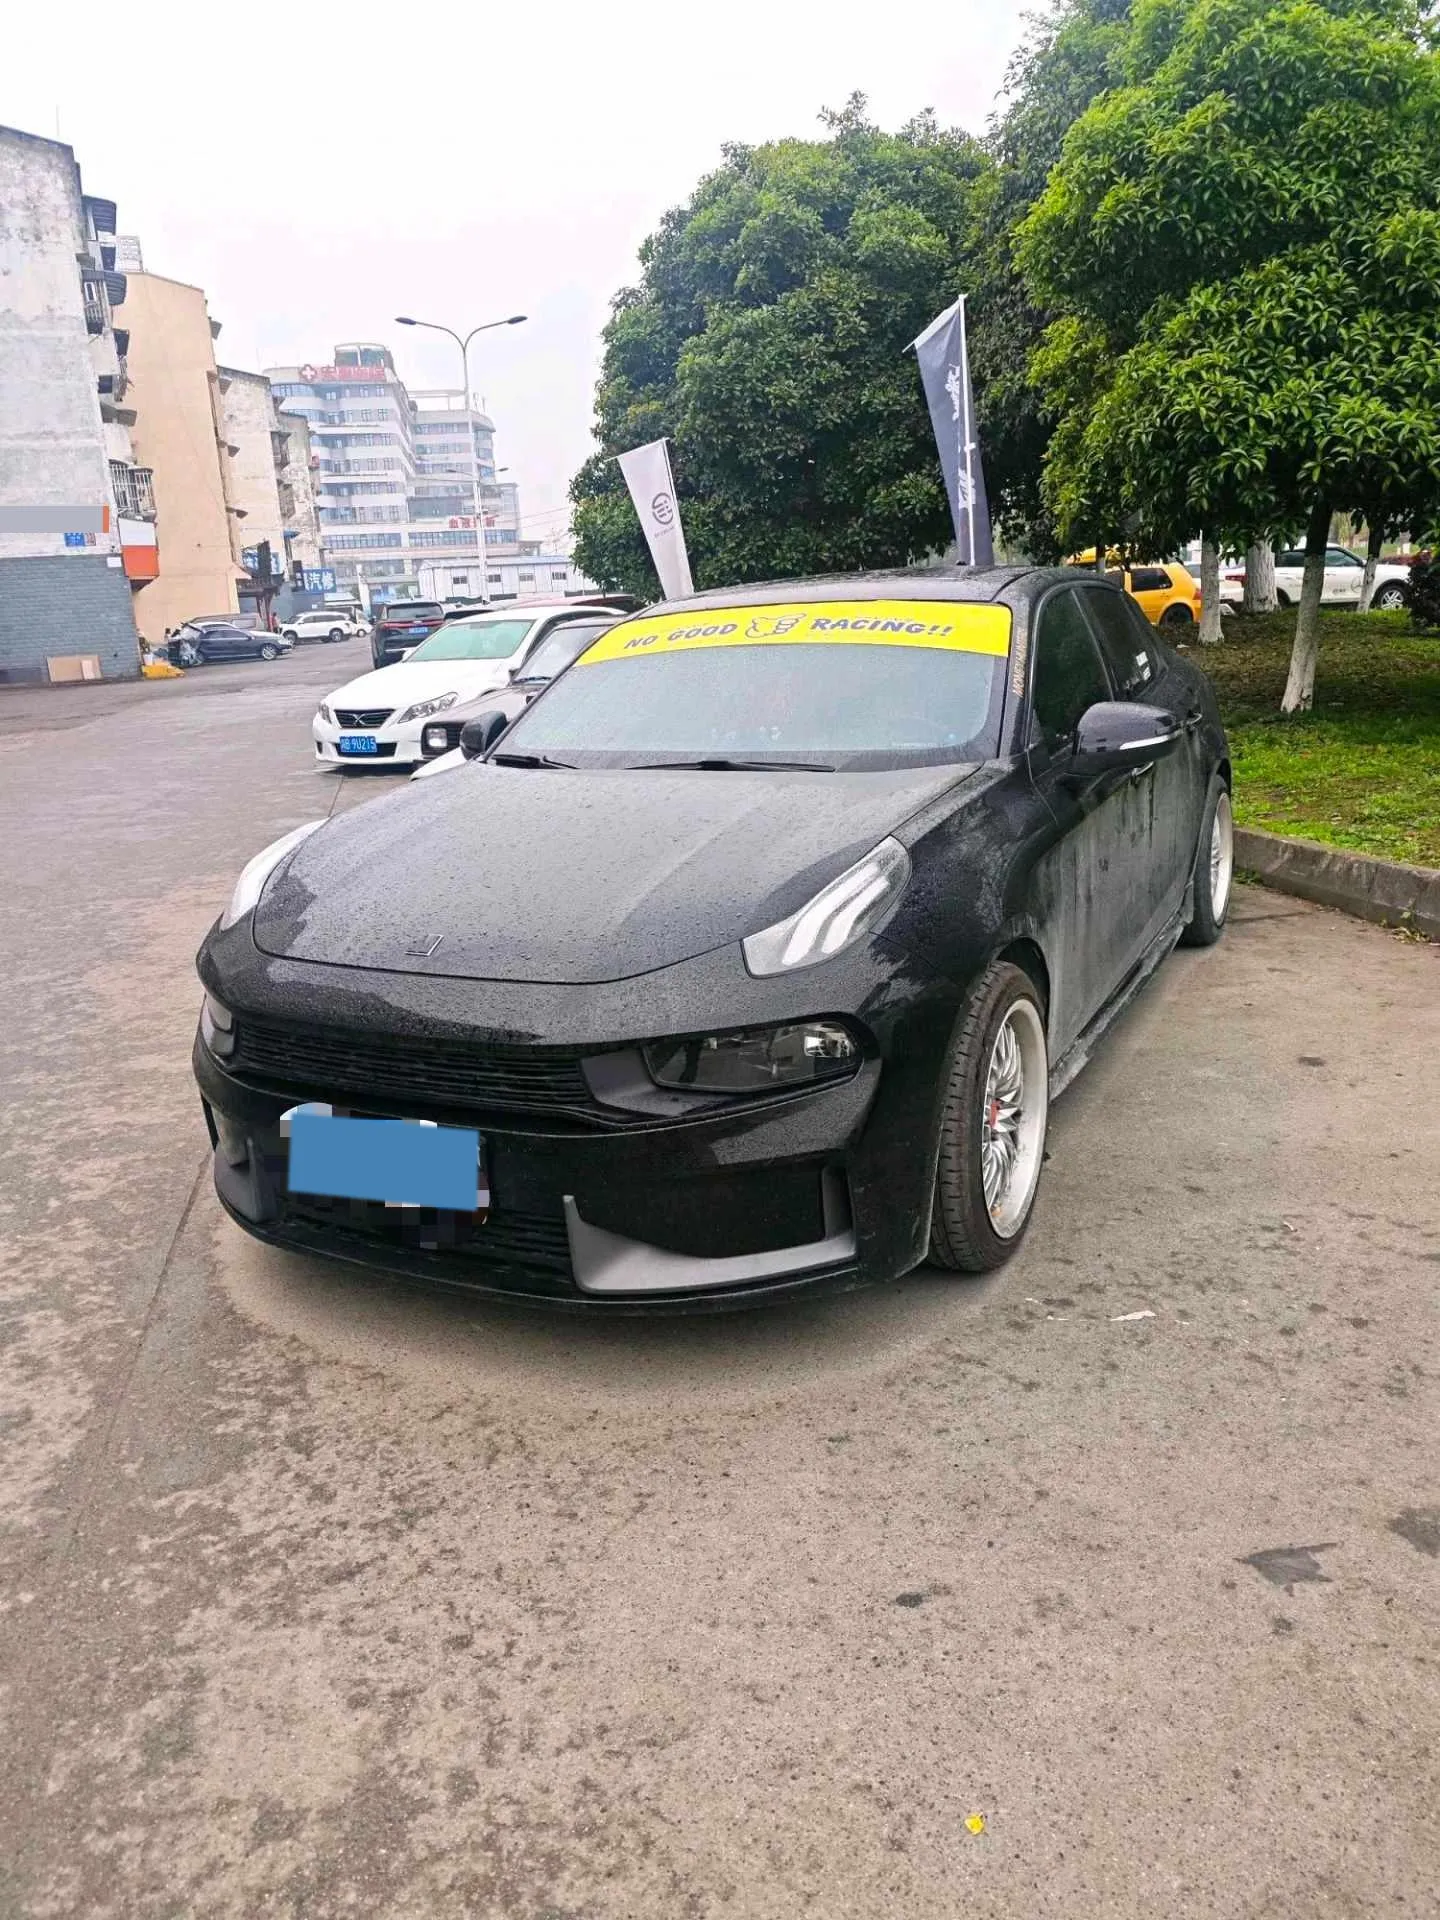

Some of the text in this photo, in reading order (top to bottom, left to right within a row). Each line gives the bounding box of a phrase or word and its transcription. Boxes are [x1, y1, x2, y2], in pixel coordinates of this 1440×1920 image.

[624, 617, 954, 649] NO GOOD RACING!!
